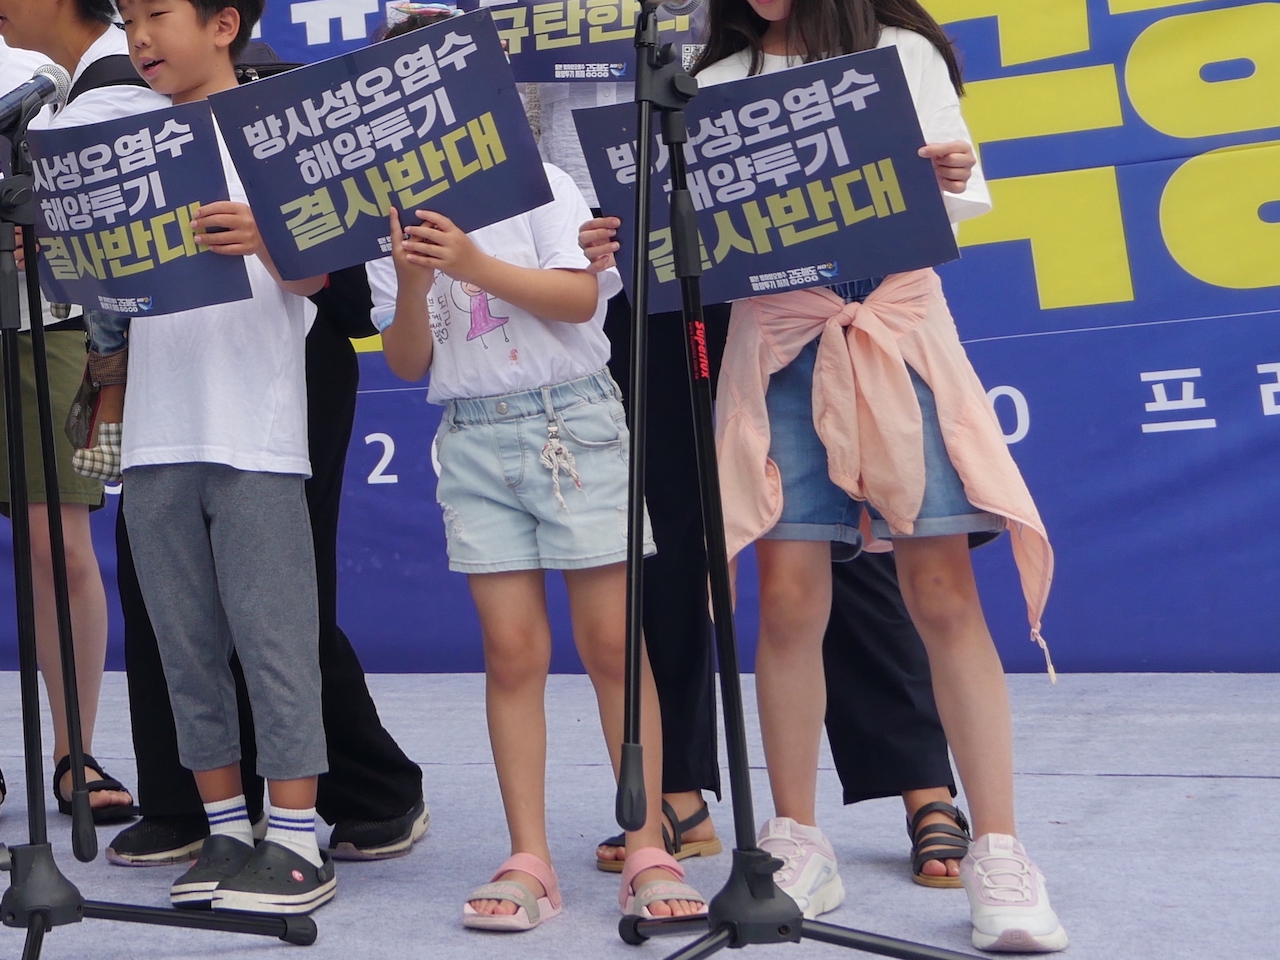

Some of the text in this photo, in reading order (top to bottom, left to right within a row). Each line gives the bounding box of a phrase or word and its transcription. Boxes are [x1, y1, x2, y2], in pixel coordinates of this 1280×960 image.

[242, 30, 477, 160] 방사성오염수
[32, 118, 194, 192] 사성오염수
[295, 86, 456, 185] 해양투기
[40, 170, 167, 232] 해양투기
[280, 111, 507, 252] 결사반대
[38, 201, 212, 281] 결사반대
[693, 320, 710, 378] Superlux
